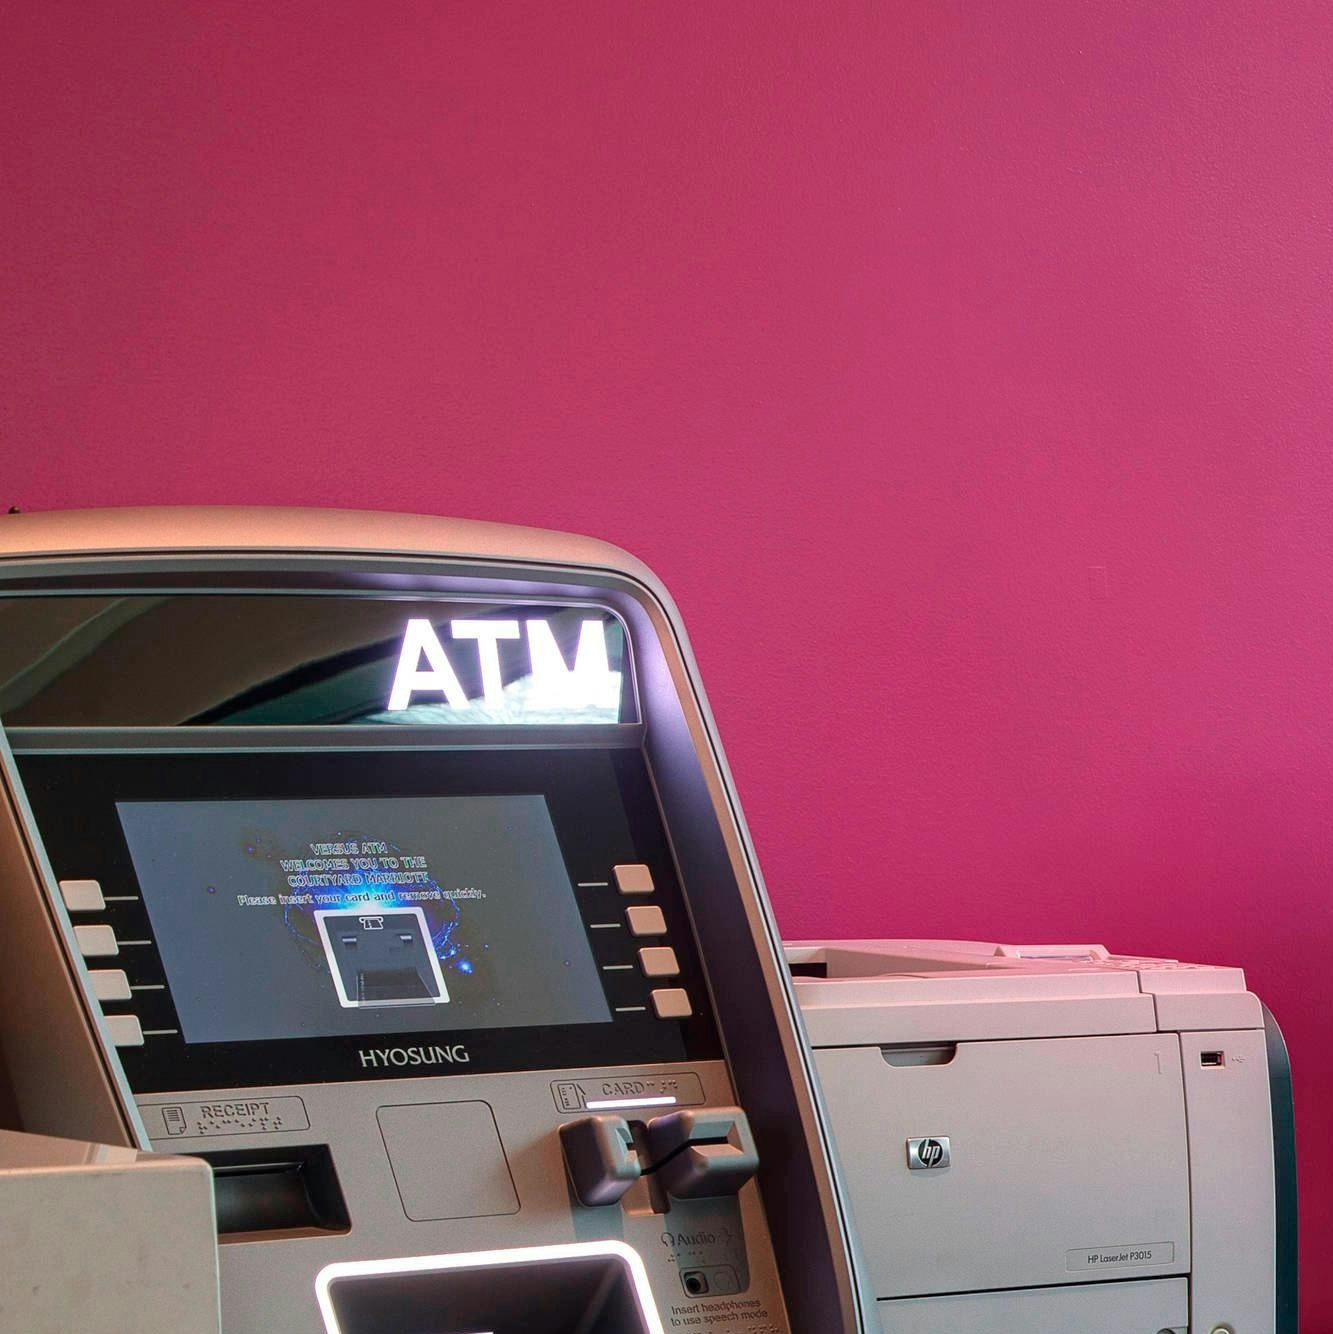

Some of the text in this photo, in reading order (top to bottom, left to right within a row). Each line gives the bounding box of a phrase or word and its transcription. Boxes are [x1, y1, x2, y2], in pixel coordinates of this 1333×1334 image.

[387, 619, 615, 711] ATM
[310, 841, 388, 856] VERSUS ATM
[280, 856, 427, 872] WELCOMES YOU TO THE
[288, 872, 428, 887] COURTYARD MARRIOTT
[237, 888, 488, 906] Please insert your card and remove quickly.
[358, 1045, 470, 1068] HYOSUNG
[602, 1081, 645, 1096] CARD
[201, 1102, 269, 1118] RECEIPT
[919, 1138, 943, 1167] hp
[677, 1232, 716, 1246] Audio
[1088, 1251, 1152, 1264] HP LaserJet P3015
[671, 1299, 762, 1315] Insert headphones
[670, 1309, 769, 1327] to use speech mode
